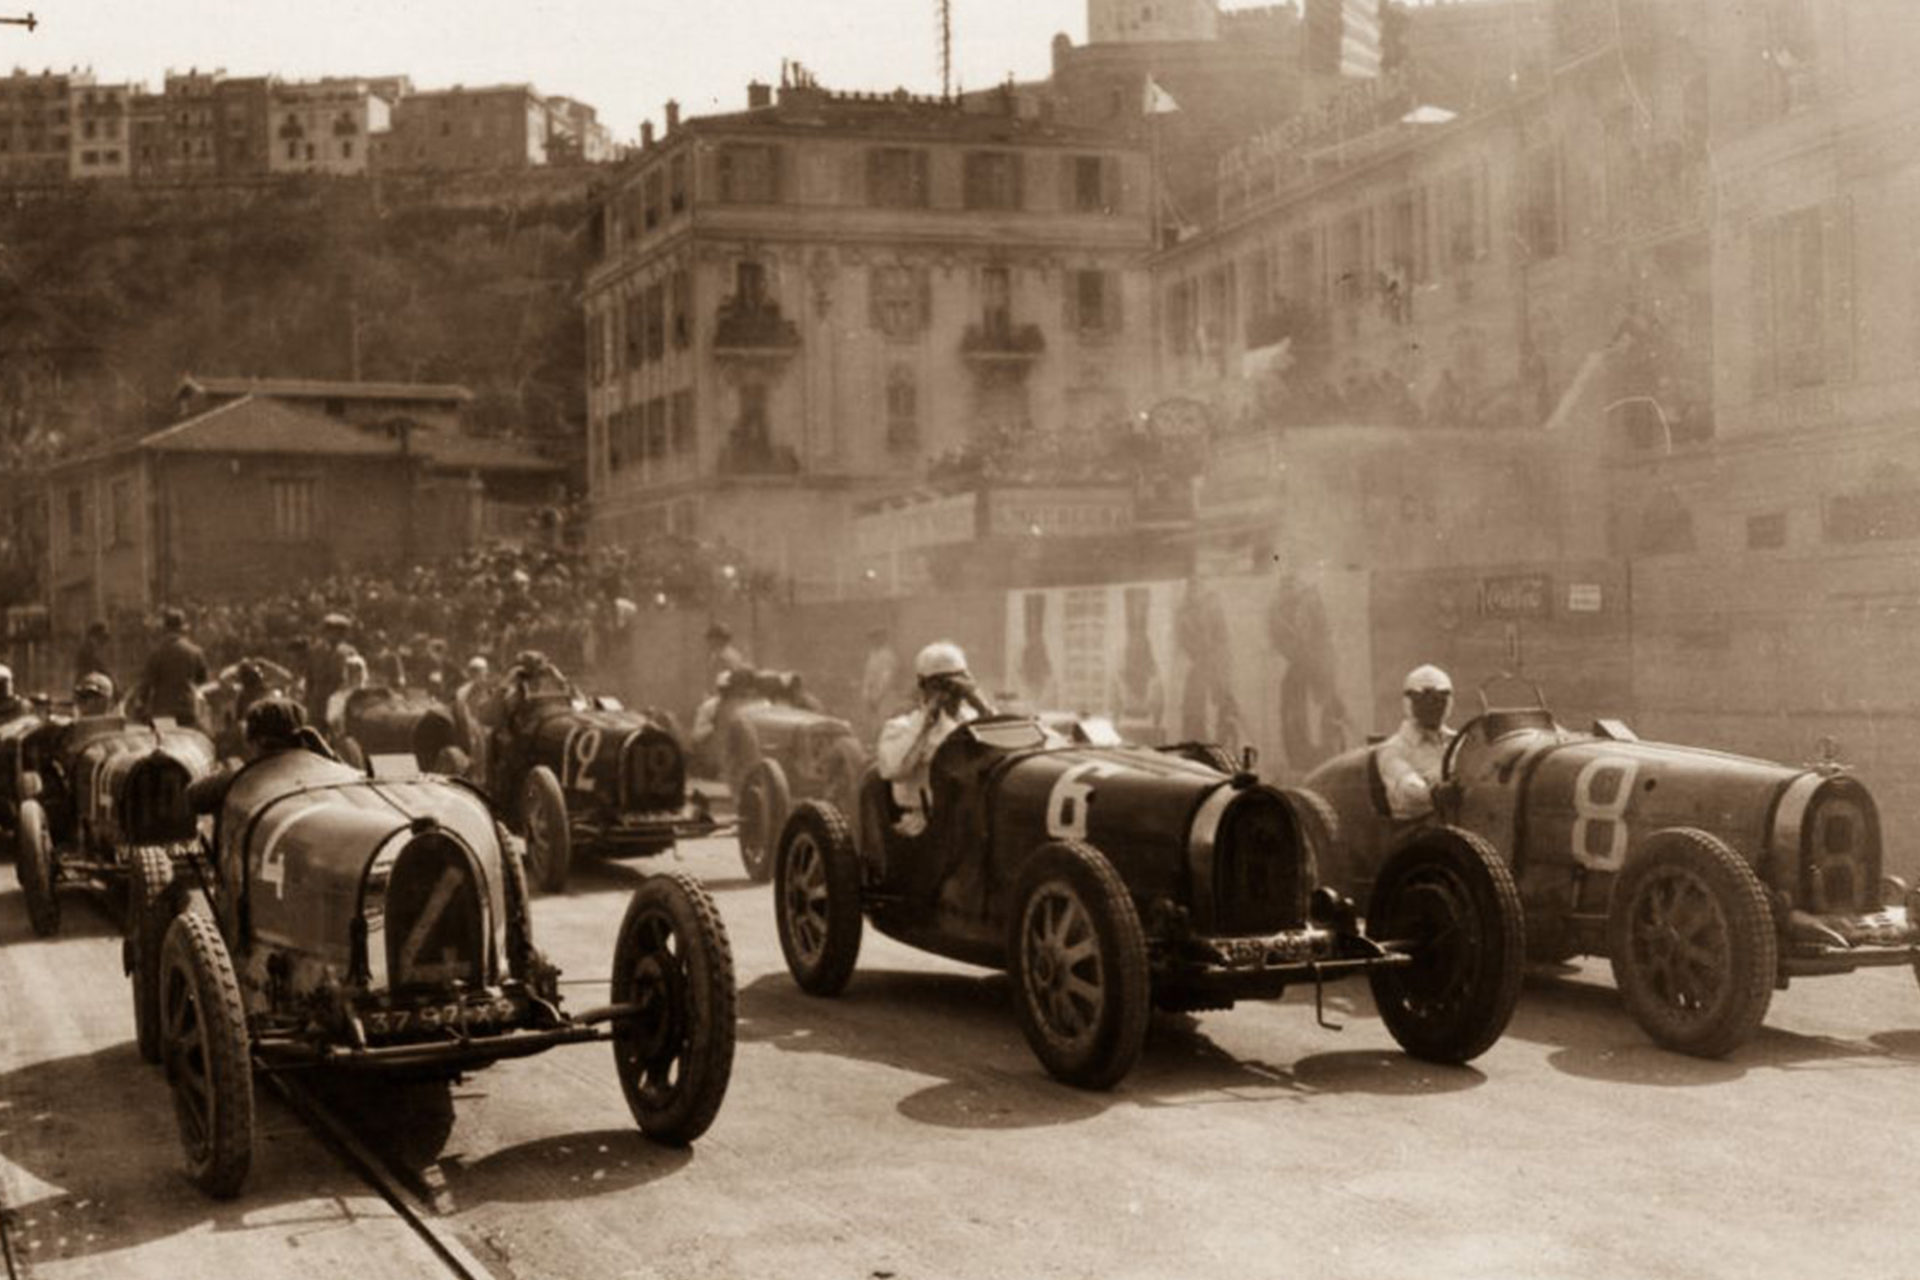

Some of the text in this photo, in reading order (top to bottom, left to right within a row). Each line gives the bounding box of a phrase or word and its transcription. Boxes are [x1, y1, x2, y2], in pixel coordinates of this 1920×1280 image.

[561, 723, 602, 791] 12
[1046, 760, 1118, 840] 6
[262, 802, 331, 900] 4
[1572, 757, 1639, 871] 8
[401, 866, 471, 986] 4
